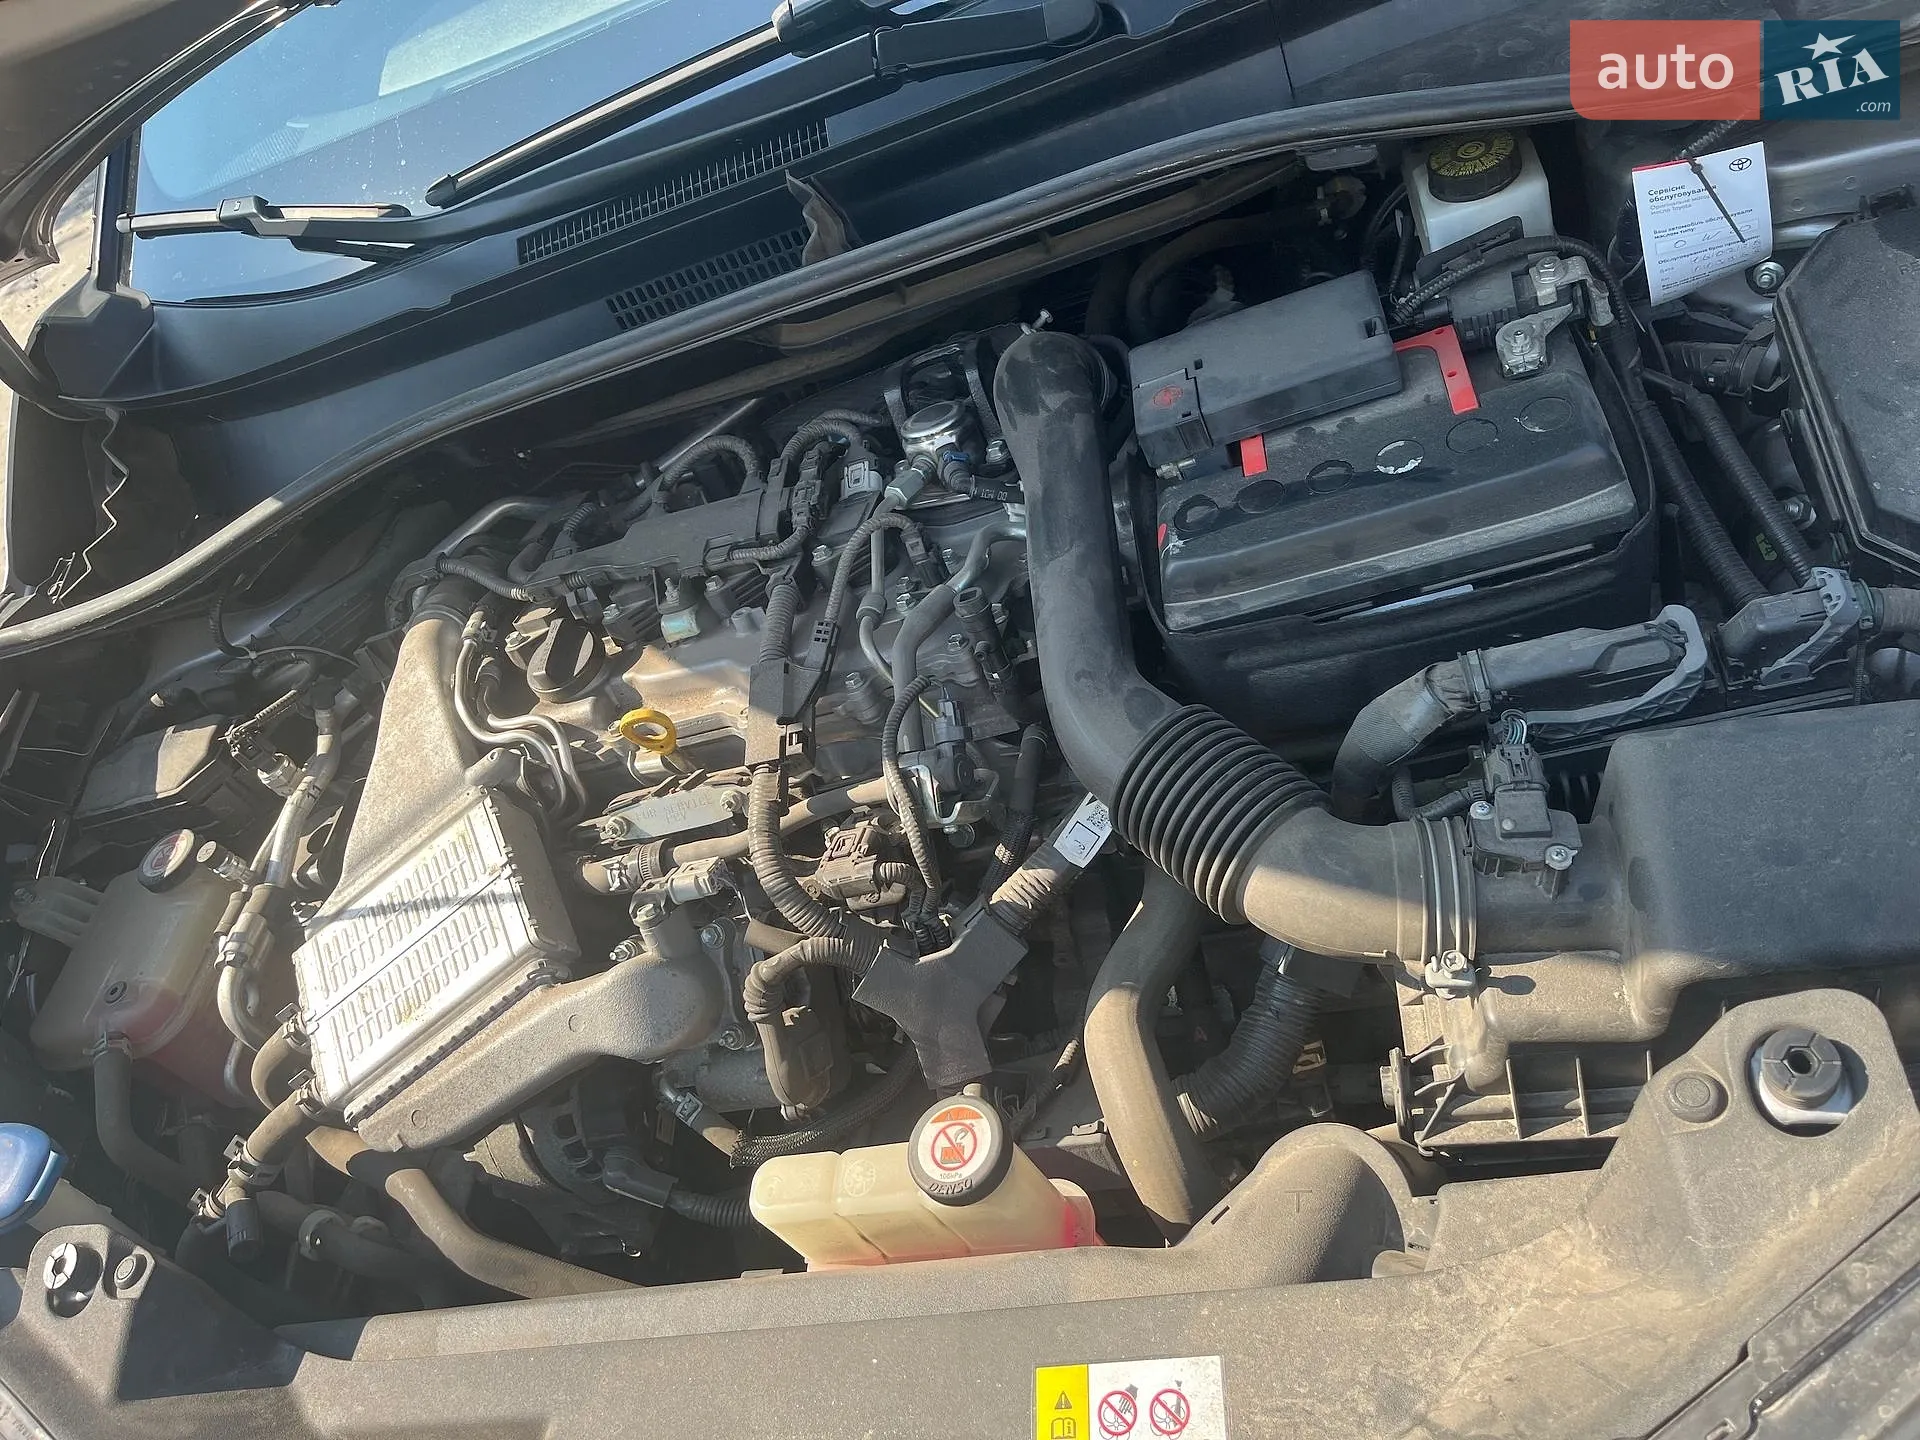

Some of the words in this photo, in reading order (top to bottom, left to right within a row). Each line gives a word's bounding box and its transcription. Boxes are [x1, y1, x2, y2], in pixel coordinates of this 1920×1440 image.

[1648, 184, 1686, 196] Сервісне
[1649, 184, 1717, 203] обслуговуваня
[928, 1178, 973, 1195] DENSO
